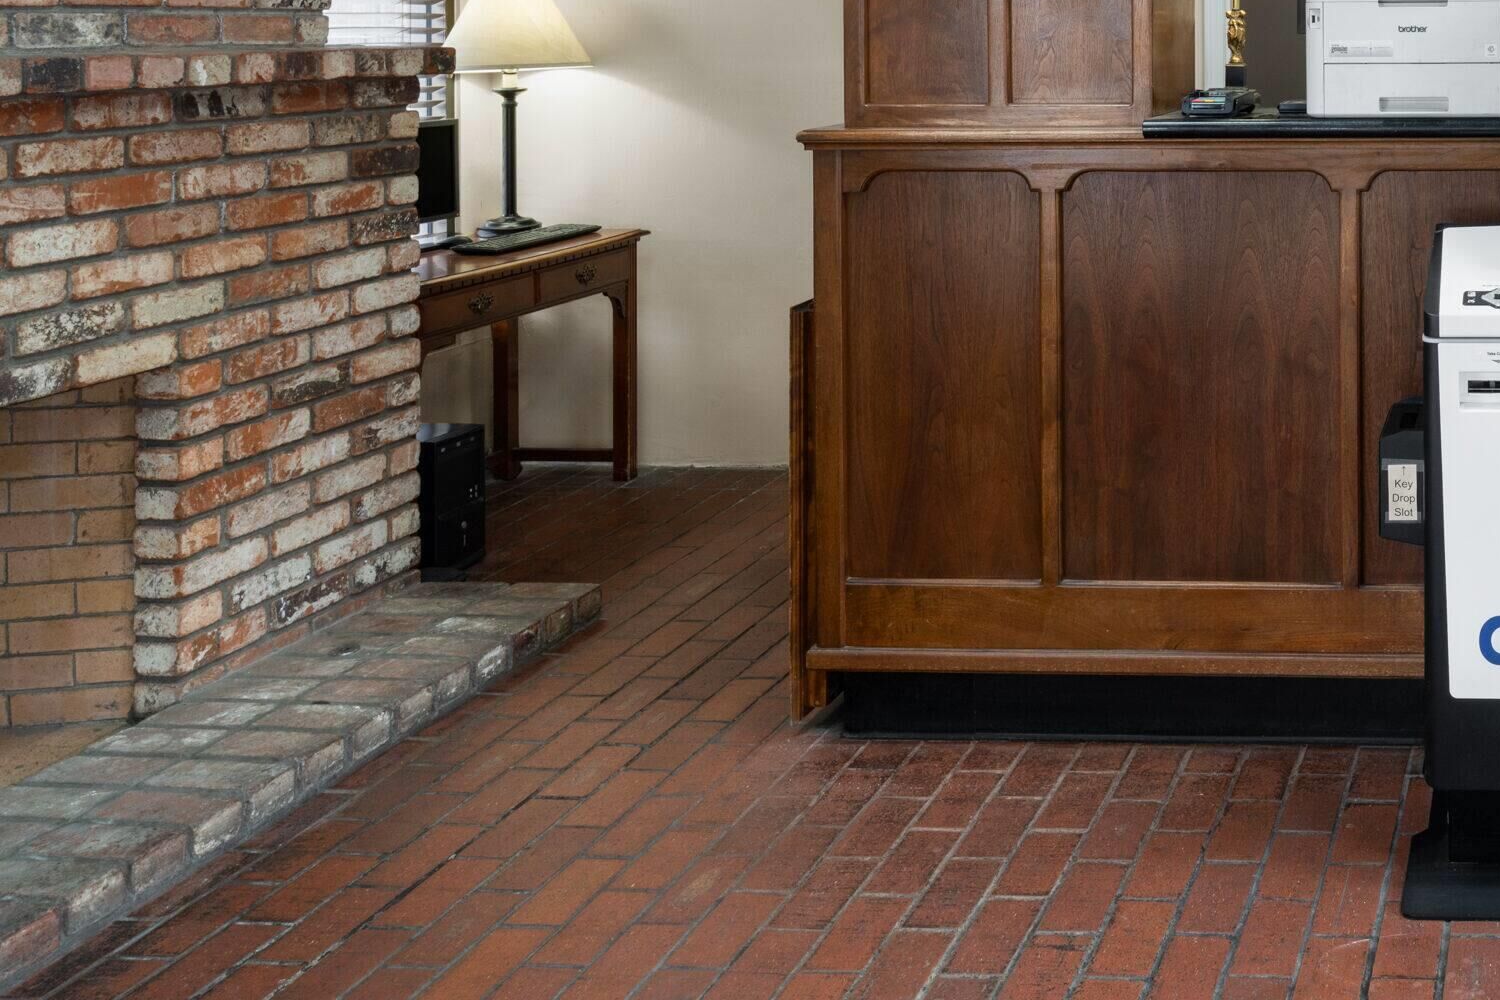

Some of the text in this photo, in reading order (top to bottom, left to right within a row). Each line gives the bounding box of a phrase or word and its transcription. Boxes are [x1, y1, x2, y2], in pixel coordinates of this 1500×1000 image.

[1398, 25, 1428, 33] brother
[1394, 479, 1414, 490] Key
[1392, 493, 1415, 504] Drop
[1394, 507, 1413, 516] Slot
